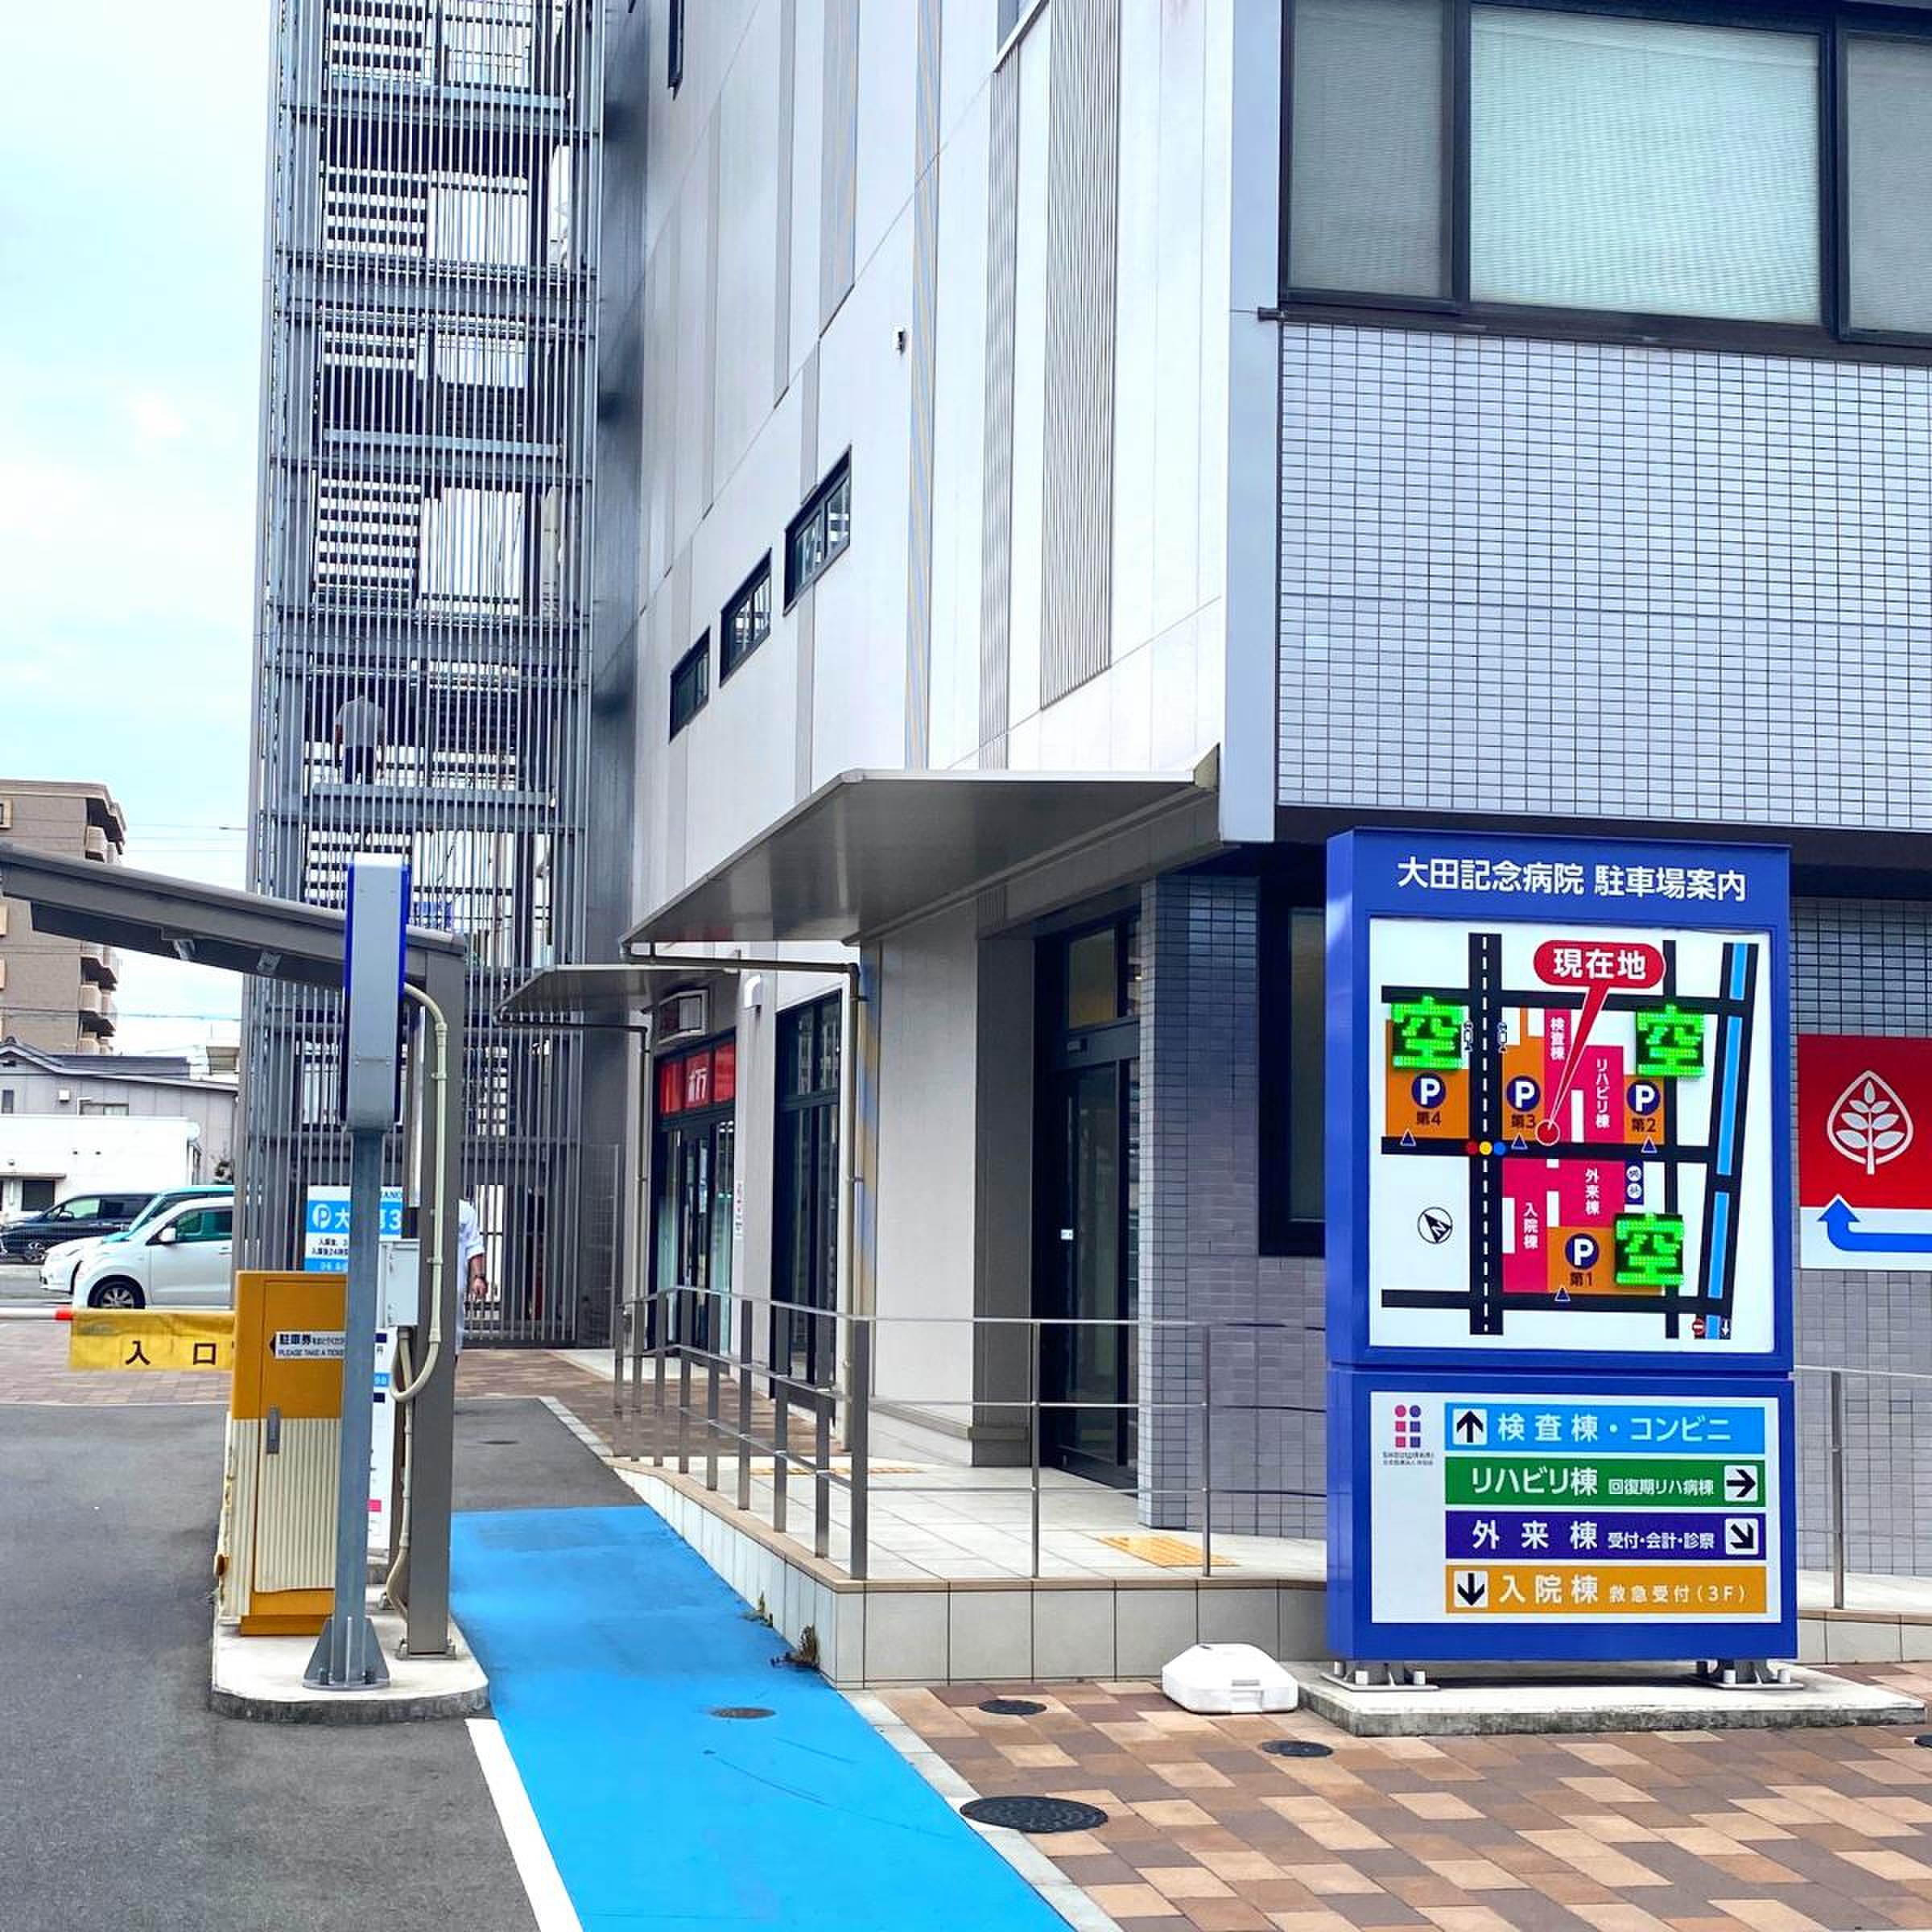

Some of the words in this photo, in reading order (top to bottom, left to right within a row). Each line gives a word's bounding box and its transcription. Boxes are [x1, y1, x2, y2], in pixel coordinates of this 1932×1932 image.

[1397, 856, 1585, 894] 大田記念病院
[1594, 865, 1746, 902] 駐車場案内
[1553, 947, 1647, 980] 現在地
[1391, 995, 1464, 1069] 空
[1637, 1004, 1705, 1077] 空
[1420, 1077, 1441, 1105] P
[1514, 1080, 1535, 1108] P
[1596, 1058, 1611, 1129] リハビリ棟
[1635, 1084, 1656, 1113] P
[1584, 1167, 1600, 1216] 外来棟
[1523, 1202, 1539, 1250] 入院棟
[1574, 1238, 1595, 1266] P
[1616, 1212, 1685, 1286] 空
[125, 1340, 217, 1366] 入口
[1472, 1466, 1598, 1496] リハビリ棟
[1608, 1478, 1714, 1496] 回復期リハ病棟
[1472, 1519, 1598, 1550] 外来棟
[1498, 1574, 1598, 1604] 入院棟
